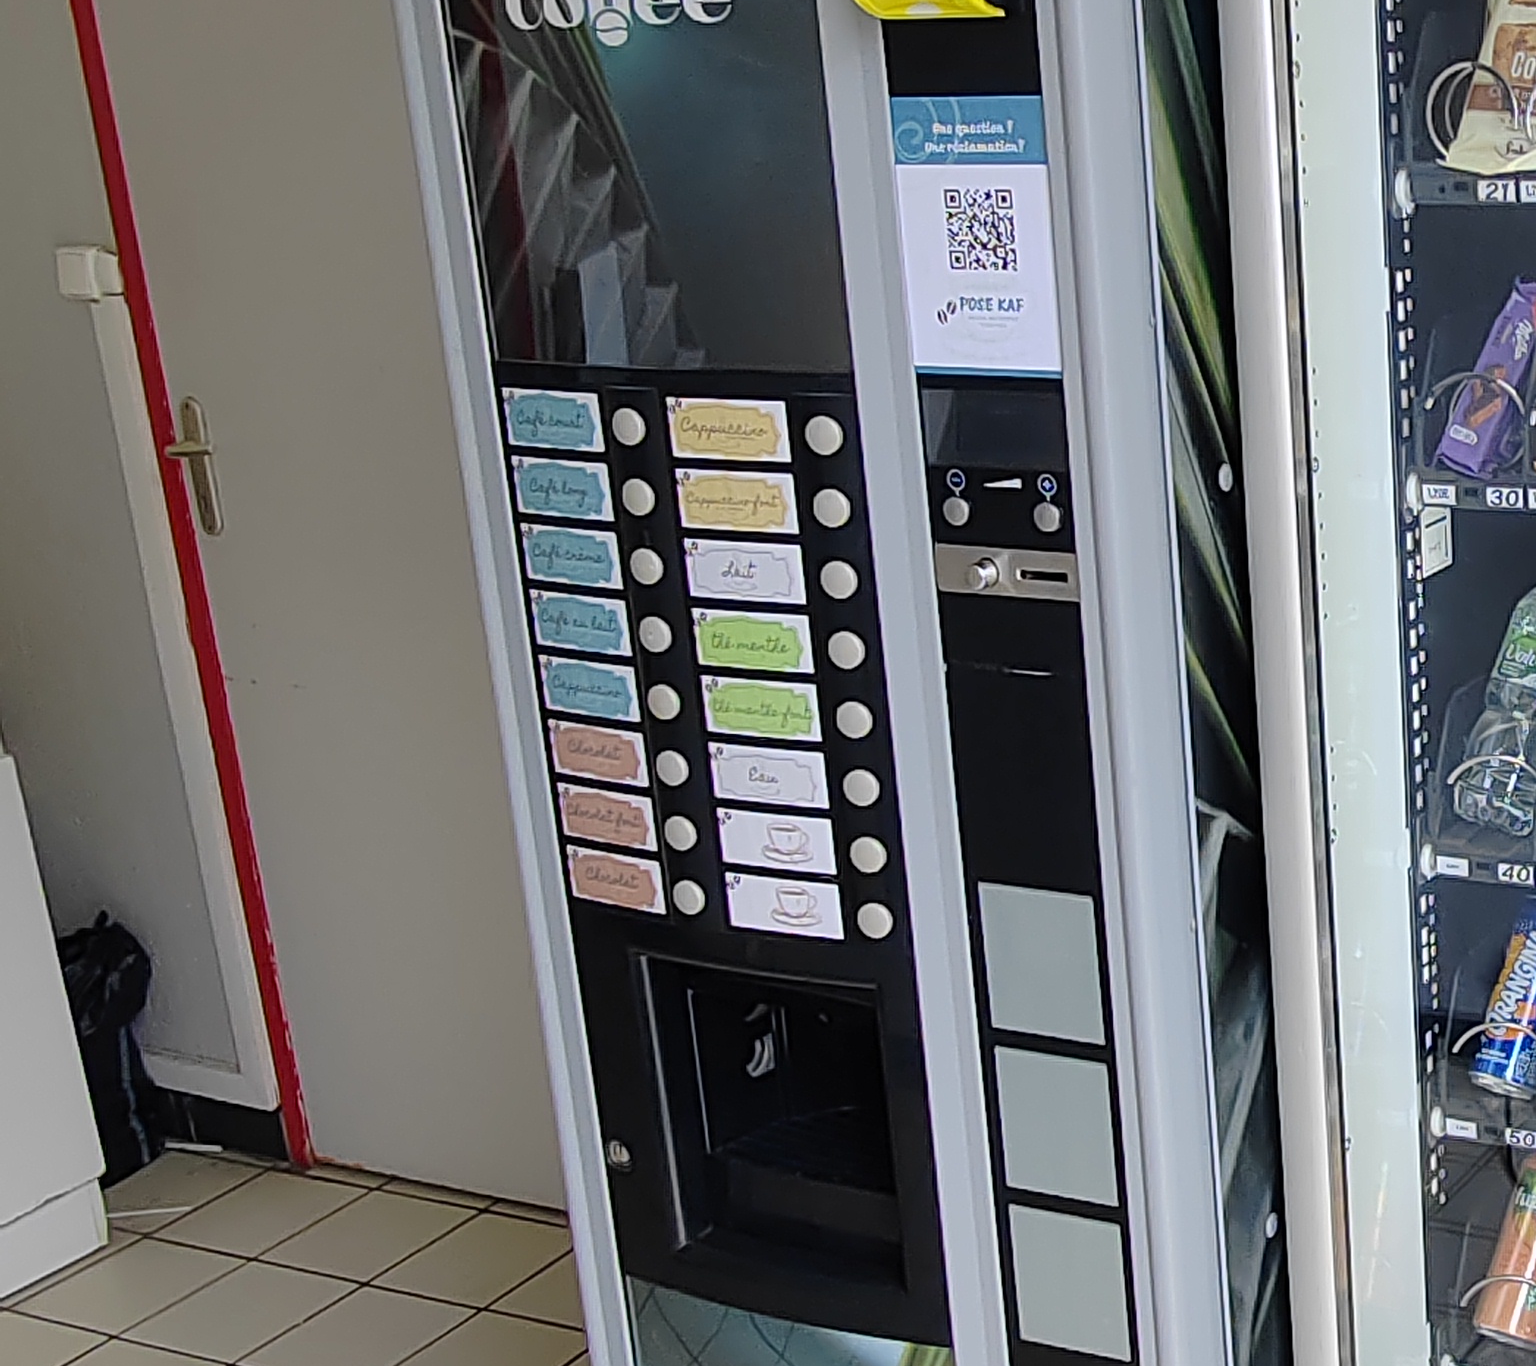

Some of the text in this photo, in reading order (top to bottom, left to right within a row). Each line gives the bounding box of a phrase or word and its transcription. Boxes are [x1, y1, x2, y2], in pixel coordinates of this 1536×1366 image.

[1485, 183, 1510, 201] 21
[959, 297, 1024, 312] POSE KAF
[1490, 490, 1519, 507] 30
[1501, 866, 1531, 883] 40
[1509, 1130, 1535, 1146] 50
